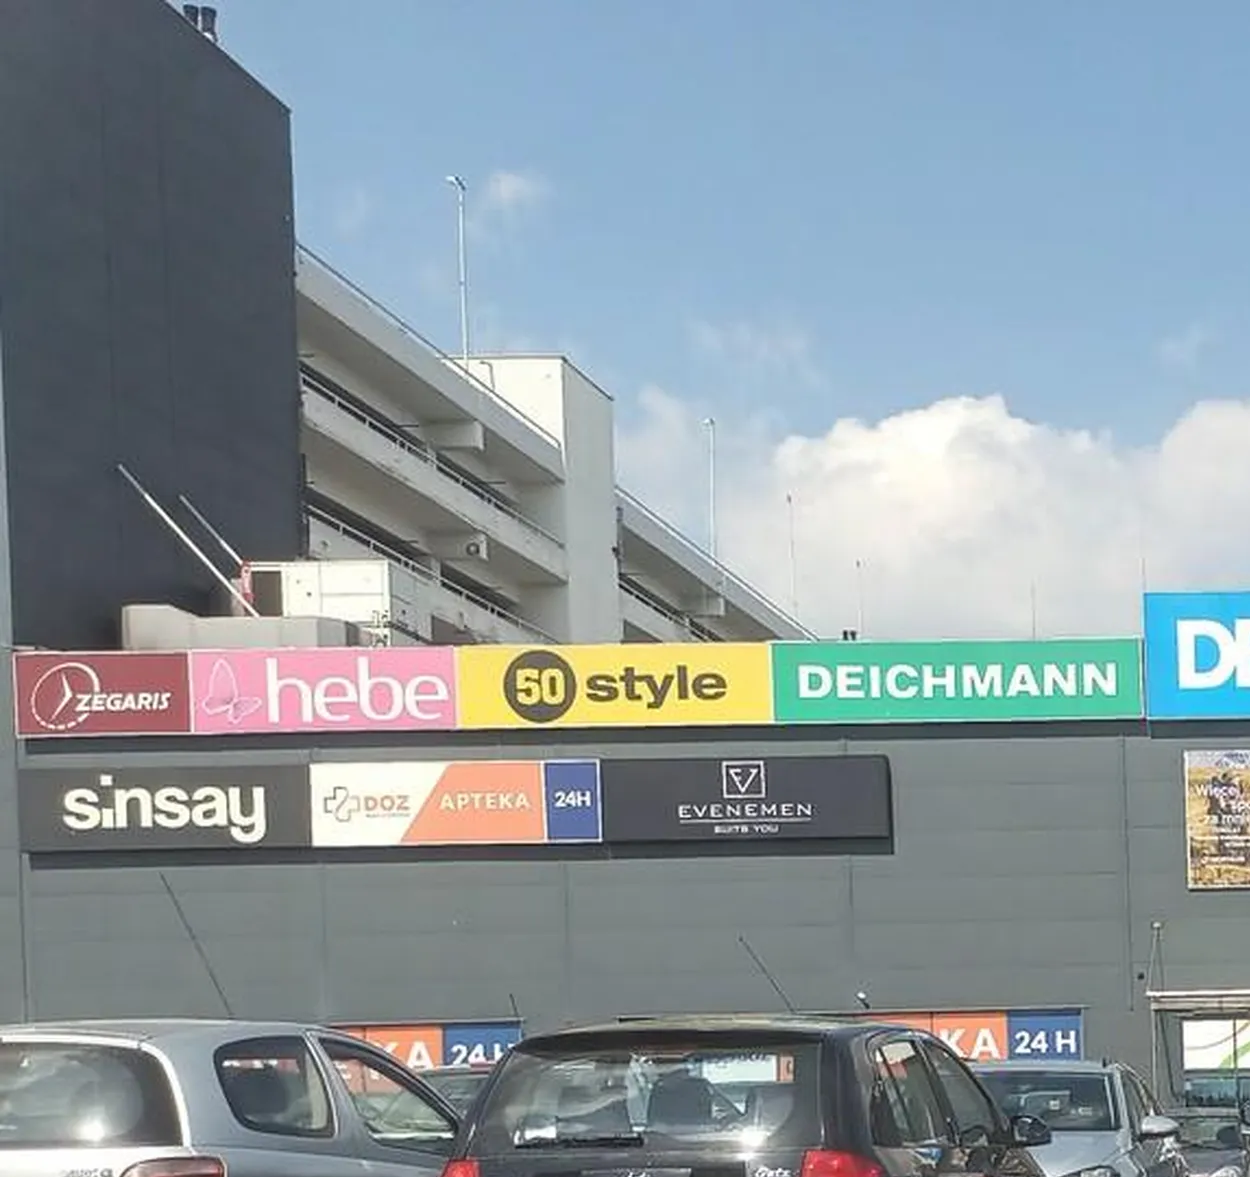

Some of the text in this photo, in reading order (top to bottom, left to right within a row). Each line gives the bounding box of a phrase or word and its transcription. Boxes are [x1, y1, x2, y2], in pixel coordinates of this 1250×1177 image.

[267, 657, 448, 724] hebe
[515, 666, 728, 709] 50 style
[799, 662, 1118, 699] DEICHMANN
[75, 692, 171, 713] ZEGARIS
[63, 775, 266, 844] sinsay
[364, 795, 410, 812] DOZ
[439, 793, 531, 811] APTEKA
[554, 790, 591, 808] 24H
[678, 804, 812, 819] EVENEMEN
